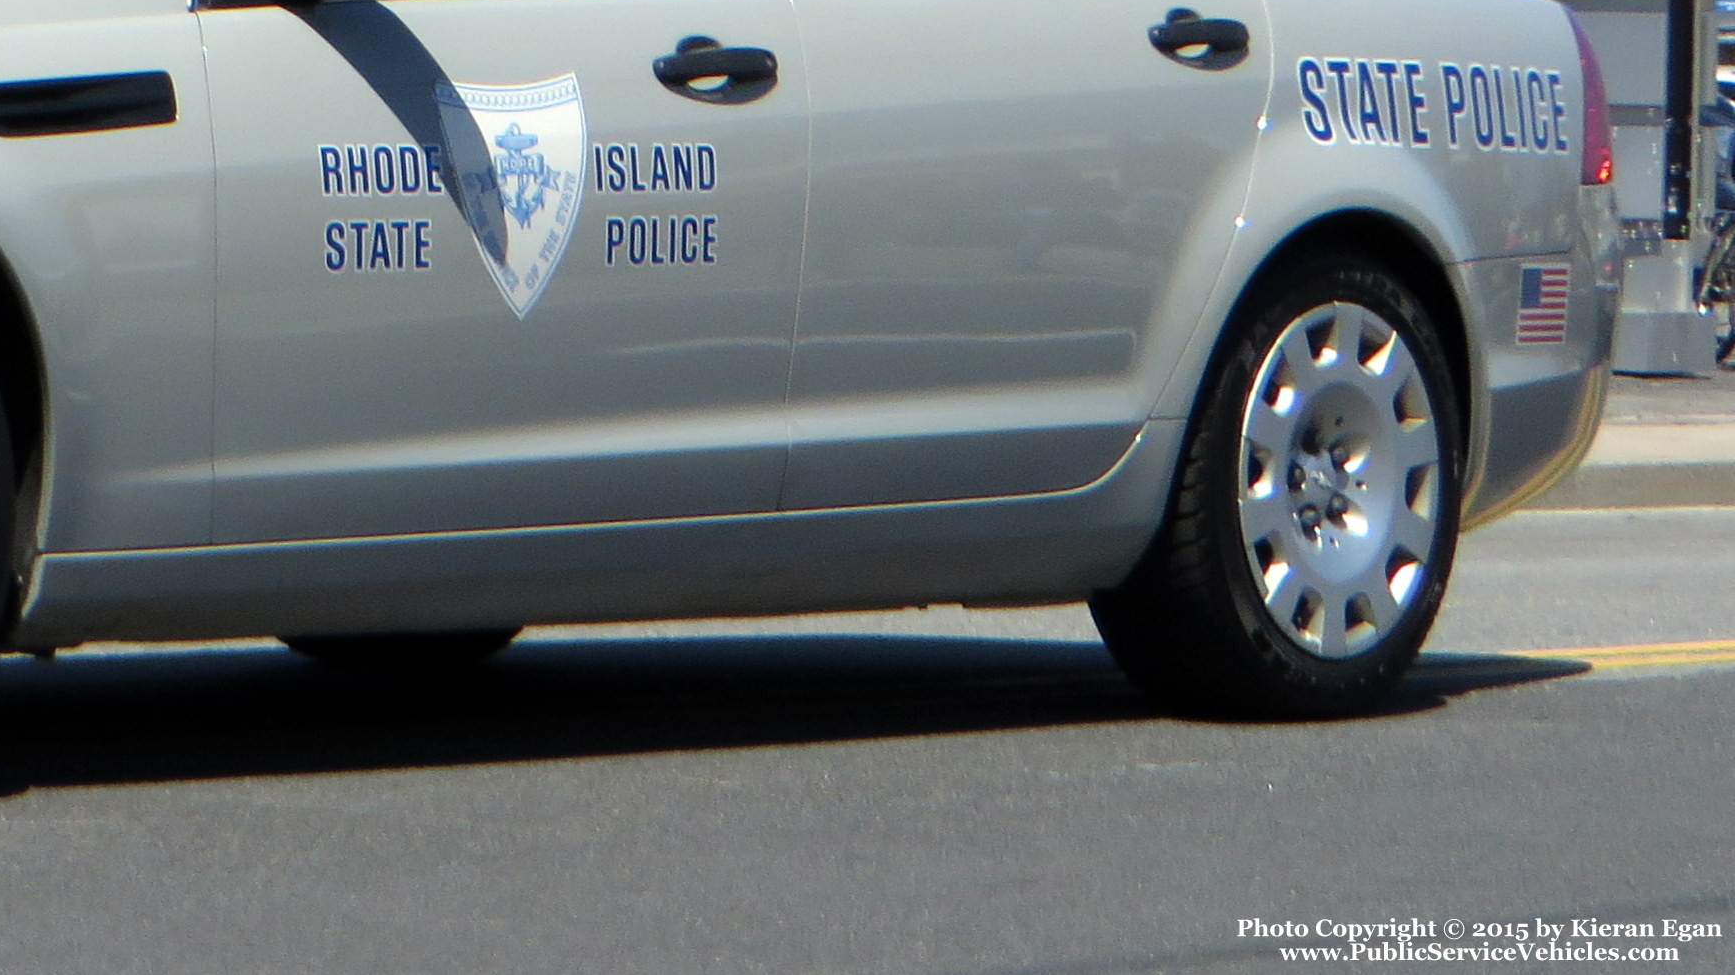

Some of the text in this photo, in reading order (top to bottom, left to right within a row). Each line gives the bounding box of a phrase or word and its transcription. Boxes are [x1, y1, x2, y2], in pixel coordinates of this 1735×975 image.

[1298, 57, 1569, 152] STATE POLICE
[319, 143, 718, 194] RHODE ISLAND
[325, 220, 432, 272] STATE
[606, 216, 719, 265] POLICE
